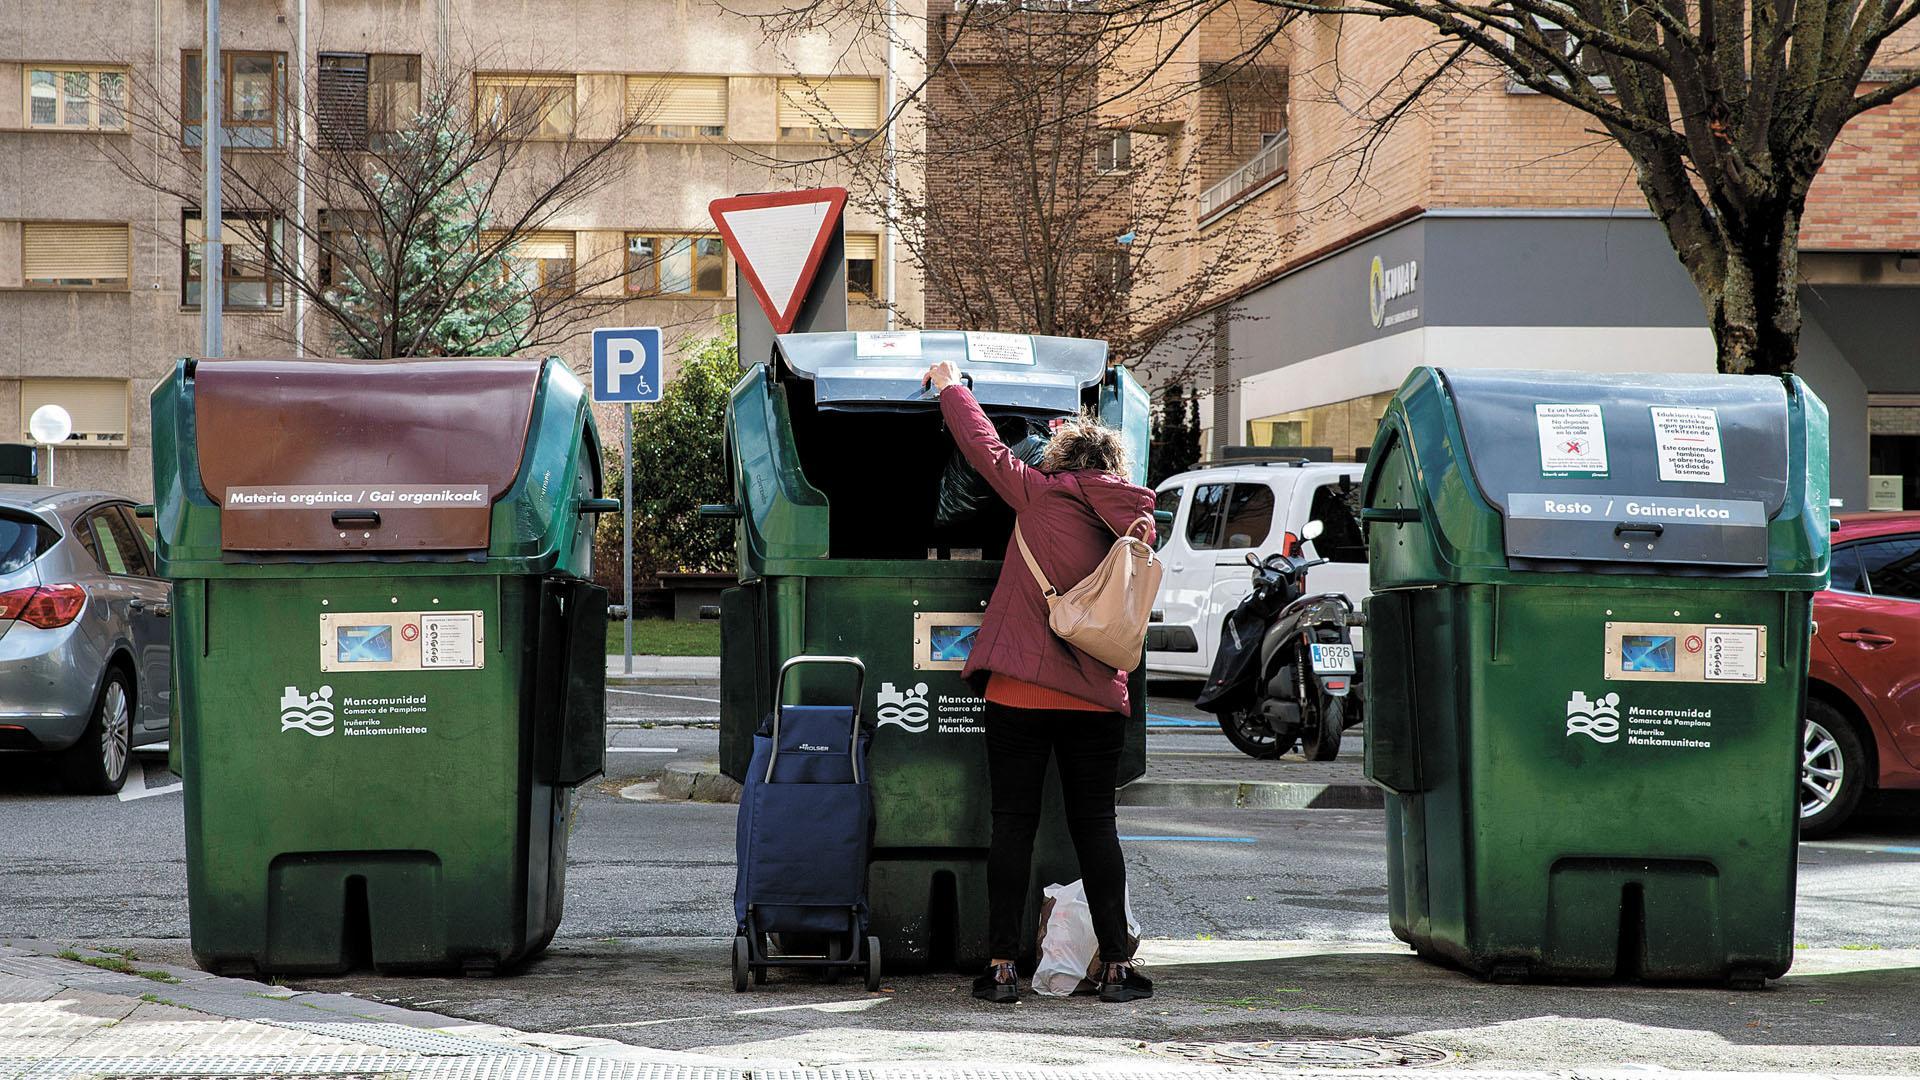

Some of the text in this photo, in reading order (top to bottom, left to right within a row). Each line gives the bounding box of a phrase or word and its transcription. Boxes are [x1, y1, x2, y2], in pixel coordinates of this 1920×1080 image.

[607, 338, 646, 393] P
[230, 490, 482, 505] Materia orgánica / Gai organikoak
[1544, 500, 1730, 519] Resto / Gainerakoa
[1321, 646, 1351, 658] 0626
[1322, 657, 1344, 669] LDV
[343, 694, 427, 706] Mancomunidad
[938, 695, 987, 704] Mancom
[389, 706, 427, 714] Pamplona
[1628, 706, 1712, 718] Mancomunidad
[343, 718, 381, 726] Iruñerriko
[938, 716, 974, 724] Iruñerriko
[1674, 719, 1711, 727] Pamplona
[344, 726, 427, 736] Mankomunitatea
[938, 724, 986, 733] Mankomu
[1628, 728, 1665, 736] Iruñerriko
[1628, 736, 1711, 748] Mankomunitatea
